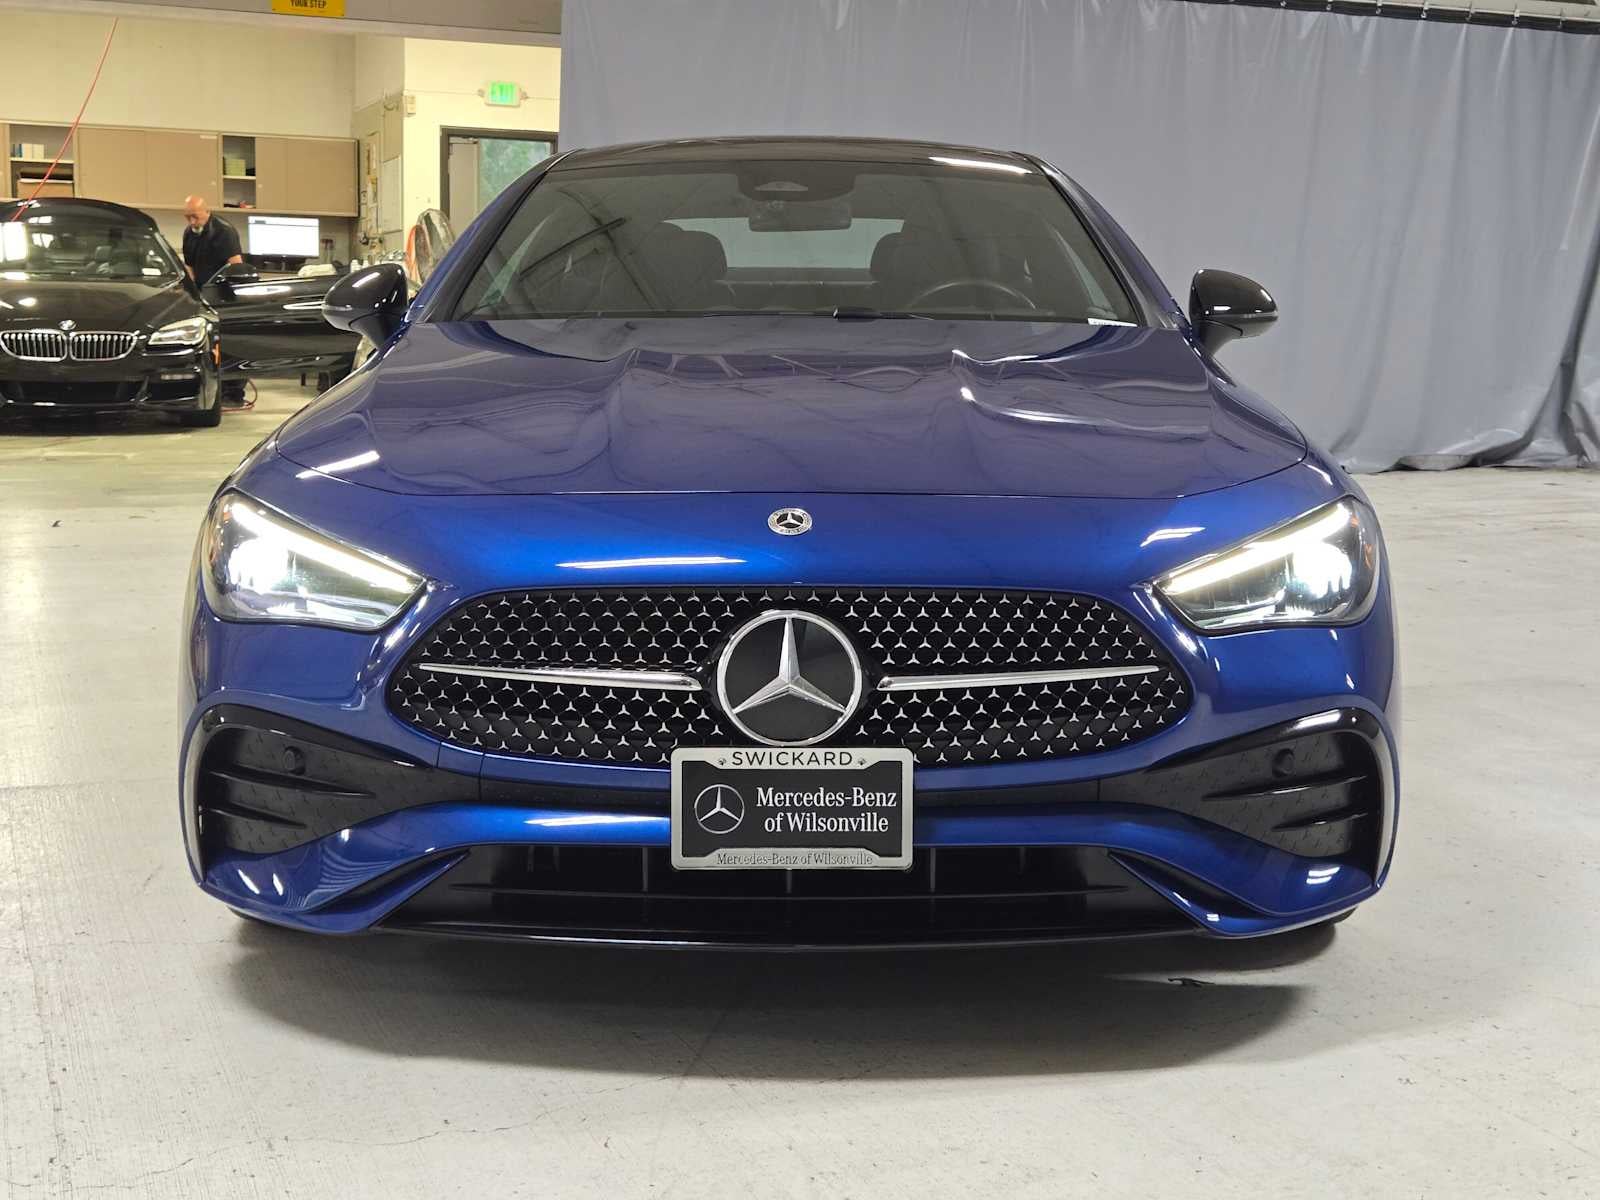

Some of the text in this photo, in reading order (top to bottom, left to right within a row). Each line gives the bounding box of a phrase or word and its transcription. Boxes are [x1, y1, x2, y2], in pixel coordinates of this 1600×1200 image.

[290, 0, 327, 8] YOUR STEP
[732, 751, 853, 766] SWICKARD
[756, 786, 897, 807] Mercedes-Benz
[764, 812, 889, 833] of Wilsonville
[717, 852, 873, 865] Mercedes-Benz of Wilsonville
